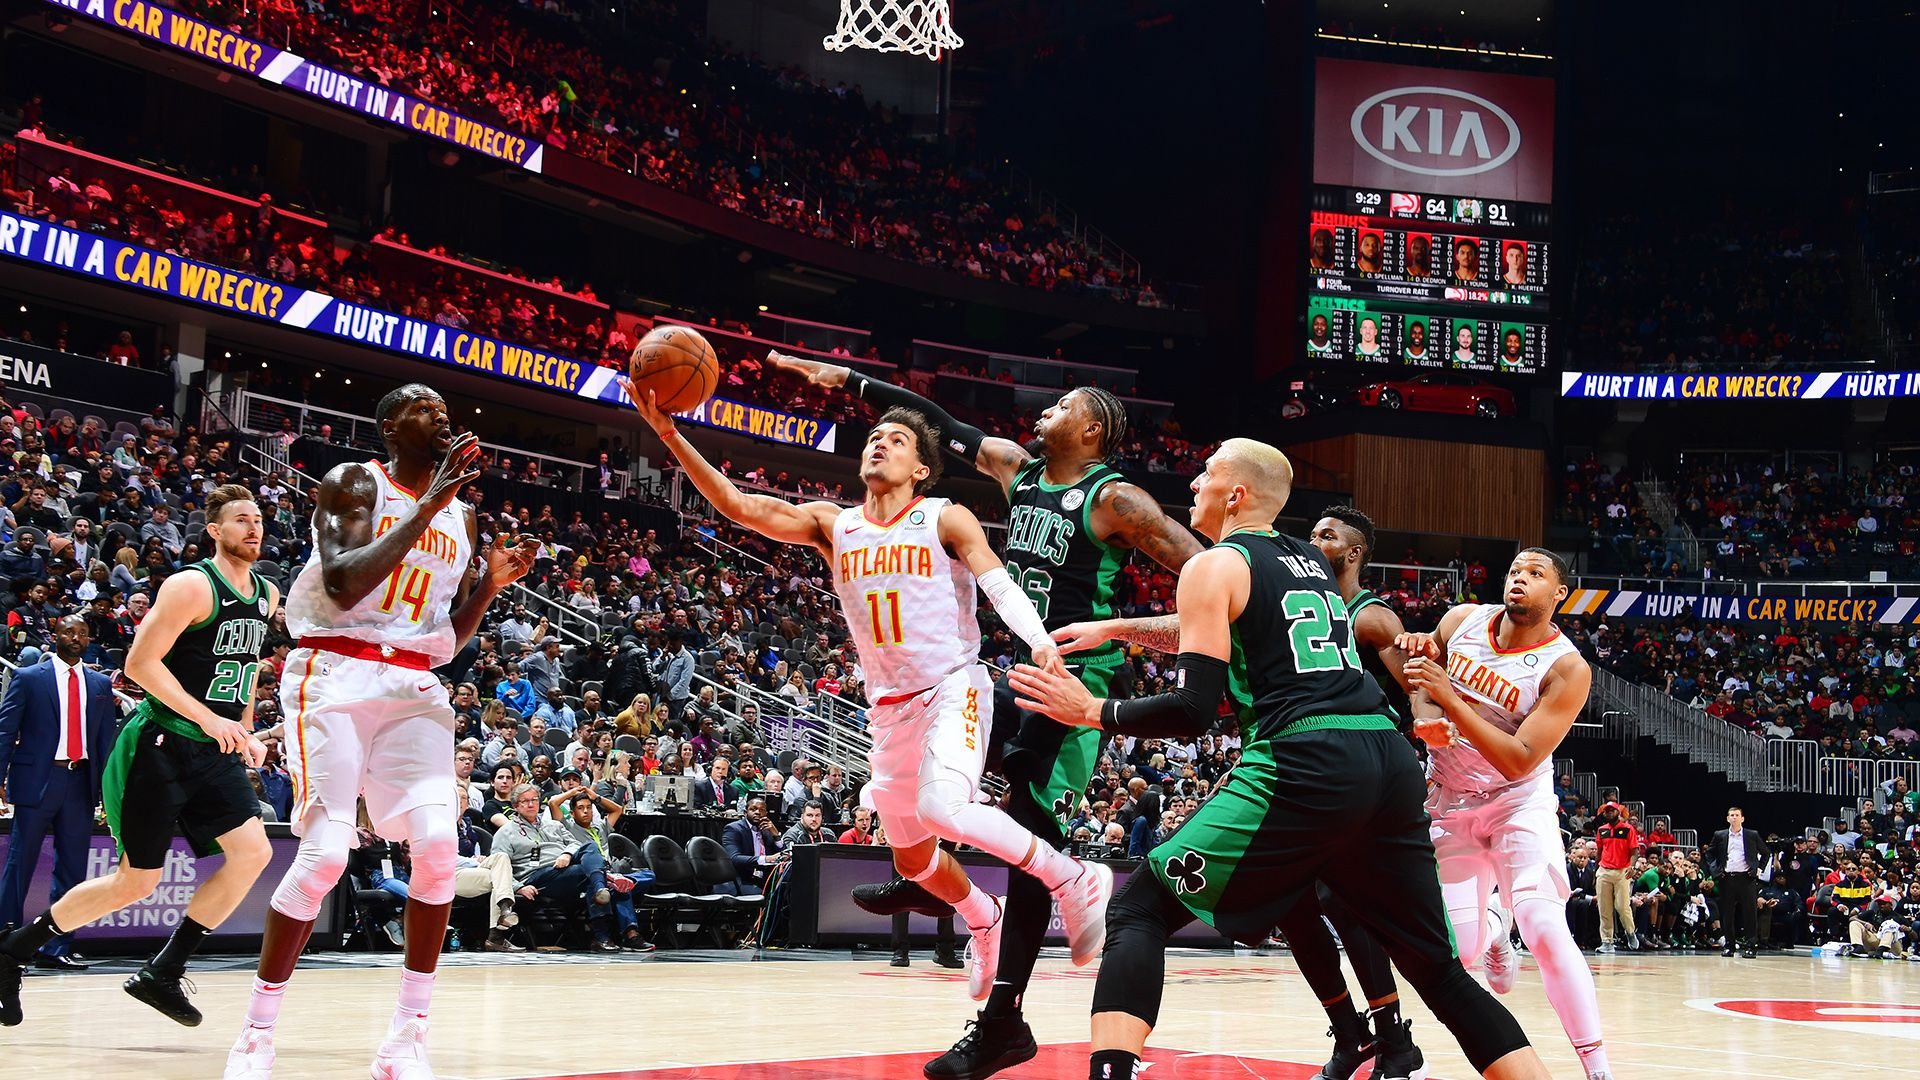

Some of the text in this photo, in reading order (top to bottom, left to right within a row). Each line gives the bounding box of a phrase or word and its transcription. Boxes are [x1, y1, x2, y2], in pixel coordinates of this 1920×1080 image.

[113, 0, 163, 39] CAR
[170, 14, 263, 73] WRECK?
[305, 64, 526, 164] HURT IN A CAR WRECK?
[1381, 103, 1491, 159] KIA
[1355, 192, 1381, 205] 9:29
[1361, 206, 1375, 214] 4TH
[1426, 198, 1446, 215] 64
[1488, 204, 1508, 220] 91
[1312, 211, 1368, 228] HAWKS
[43, 227, 79, 268] IN
[83, 239, 104, 275] A
[114, 246, 172, 291] CAR
[179, 261, 283, 318] WRECK?
[1374, 273, 1403, 281] SPELLMAN
[1310, 296, 1366, 311] CELTICS
[1377, 285, 1429, 296] TURNOVER RATE
[1468, 291, 1488, 300] 18.2%
[1512, 295, 1530, 304] 11%
[334, 302, 399, 347] HURT
[401, 320, 428, 354] IN
[430, 328, 446, 360] A
[453, 333, 496, 371] CAR
[501, 345, 581, 391] WRECK?
[0, 354, 51, 388] ENA
[1844, 373, 1900, 397] HURT
[1584, 375, 1802, 398] HURT IN A CAR WRECK?
[692, 399, 818, 446] A CAR WRECK?
[1007, 504, 1075, 566] CELTICS
[840, 543, 933, 584] ATLANTA
[1277, 554, 1329, 580] THEIS
[379, 562, 432, 624] 14
[866, 589, 905, 647] 11
[1702, 596, 1723, 619] IN
[1727, 597, 1740, 619] A
[1747, 598, 1787, 621] CAR
[1794, 598, 1877, 621] WRECK?
[1281, 589, 1364, 674] 27
[205, 659, 258, 704] 20
[1448, 652, 1520, 713] ATLANTA
[961, 686, 978, 751] HAWKS
[86, 907, 189, 928] ASINO
